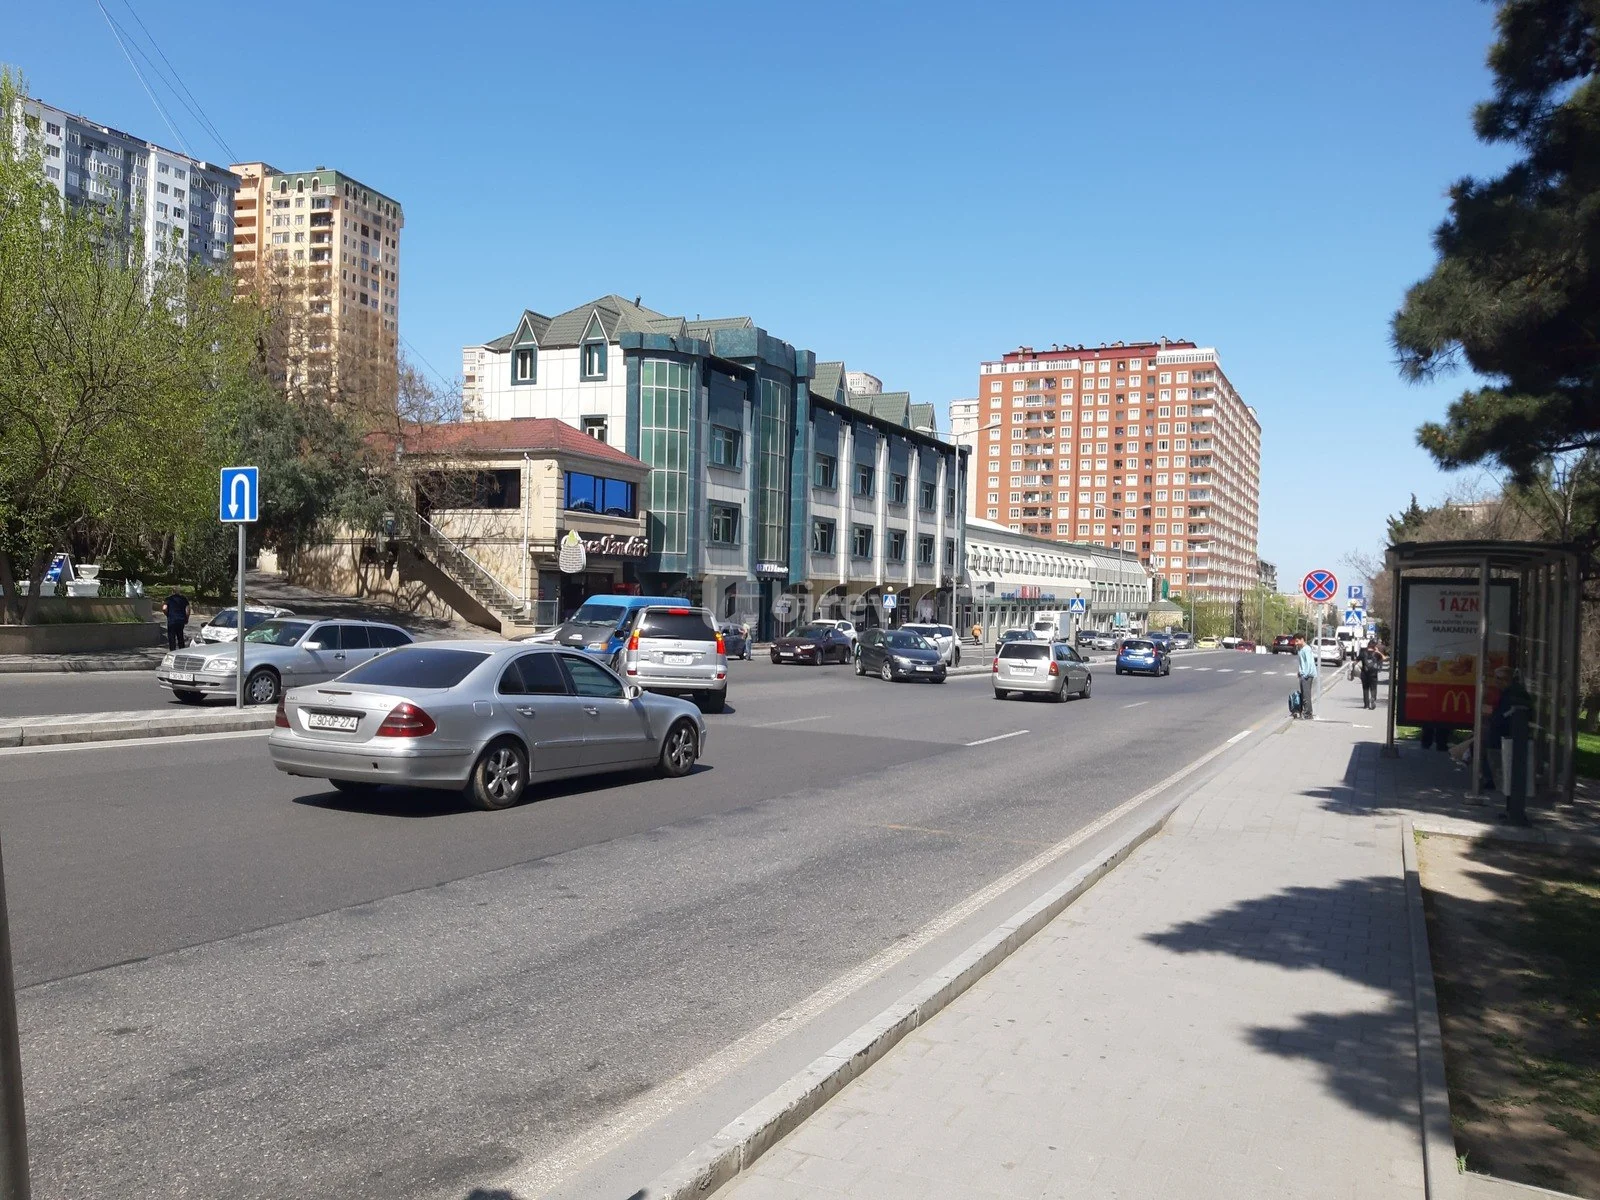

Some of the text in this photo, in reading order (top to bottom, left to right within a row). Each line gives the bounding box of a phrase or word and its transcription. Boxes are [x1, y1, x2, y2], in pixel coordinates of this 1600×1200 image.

[1351, 586, 1361, 597] P
[1439, 597, 1480, 612] 1 AZN
[1432, 626, 1478, 634] MAKMENY
